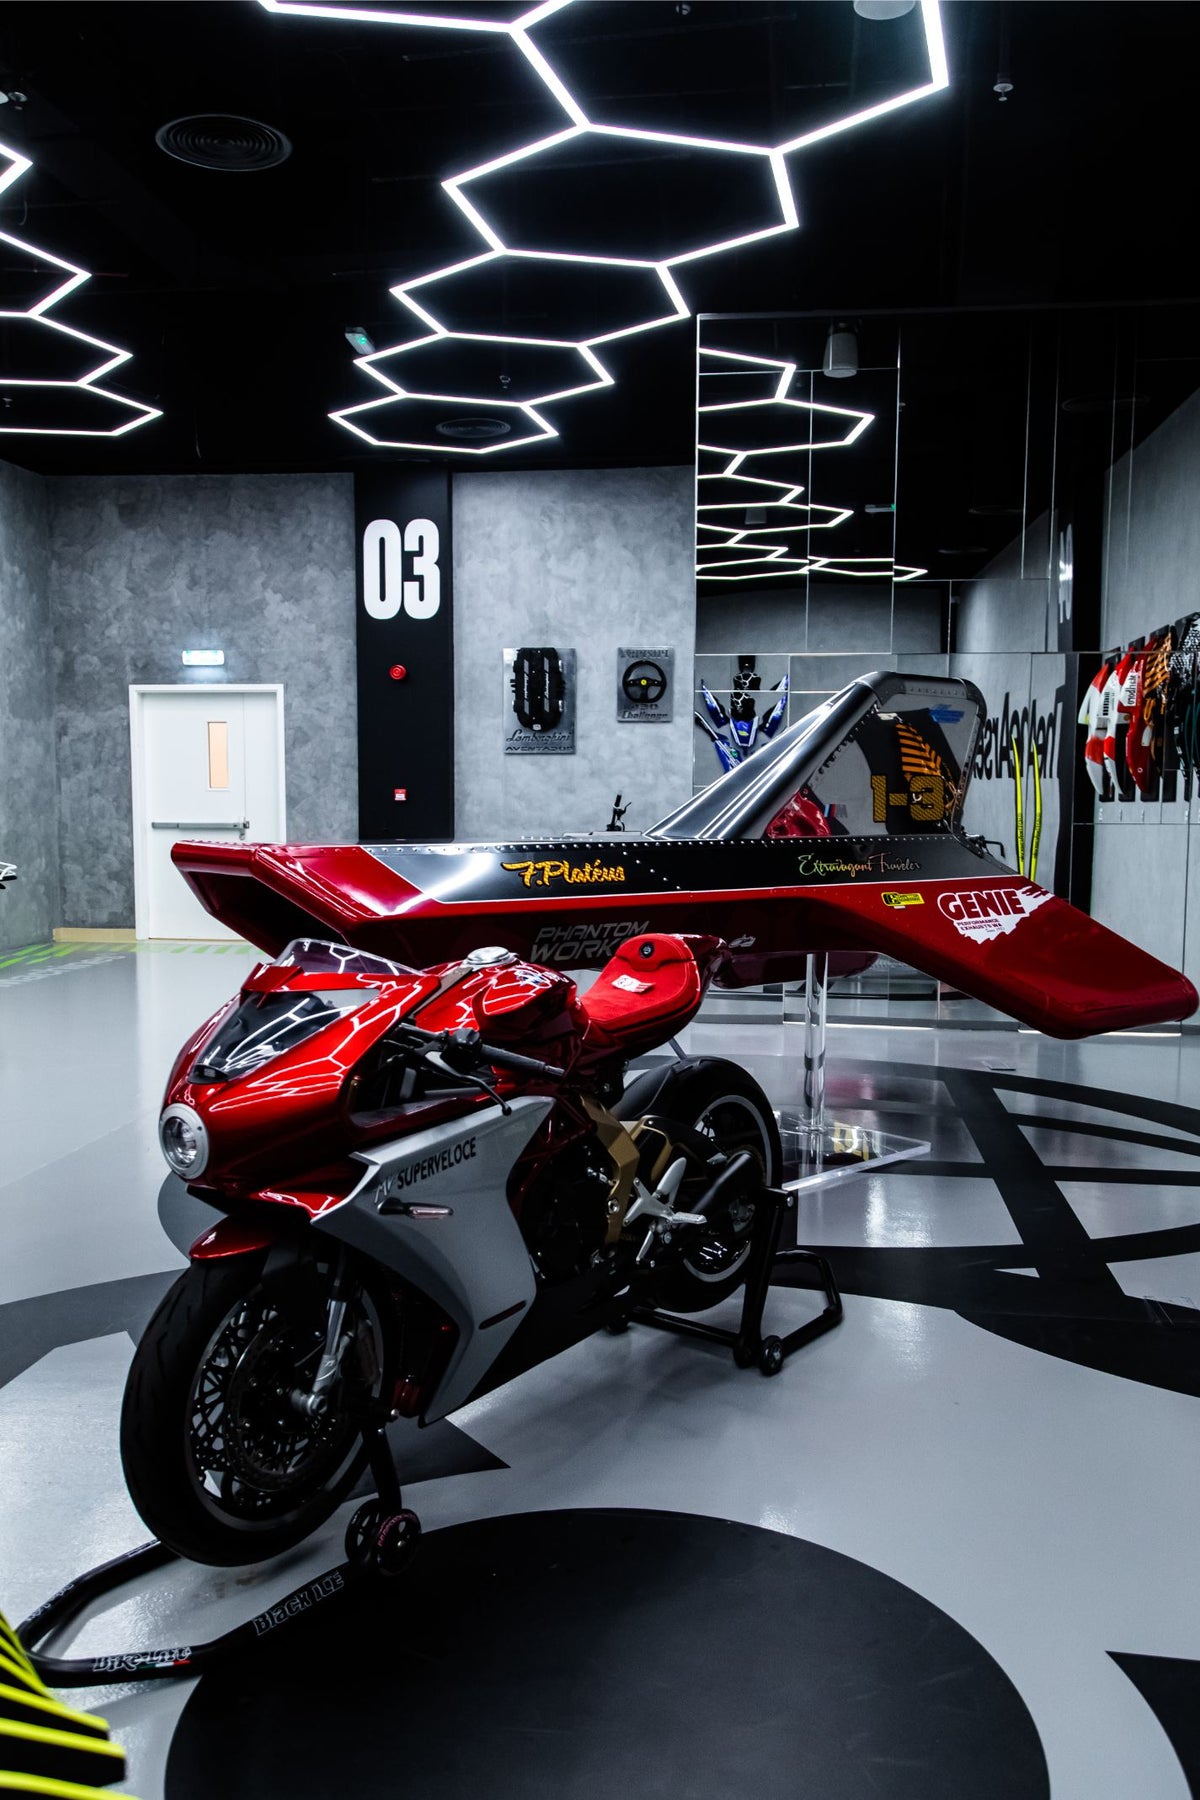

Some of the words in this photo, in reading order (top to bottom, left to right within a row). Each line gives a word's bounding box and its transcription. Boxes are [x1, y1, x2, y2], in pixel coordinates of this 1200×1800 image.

[362, 518, 441, 620] 03
[798, 853, 875, 878] Extravagant
[868, 851, 921, 873] Traveler
[938, 889, 1026, 920] GENIE
[535, 920, 650, 943] PHANTOM
[956, 918, 1000, 927] PERFORMANCE
[529, 938, 628, 963] WORK
[397, 1137, 477, 1190] SUPERVELOCE
